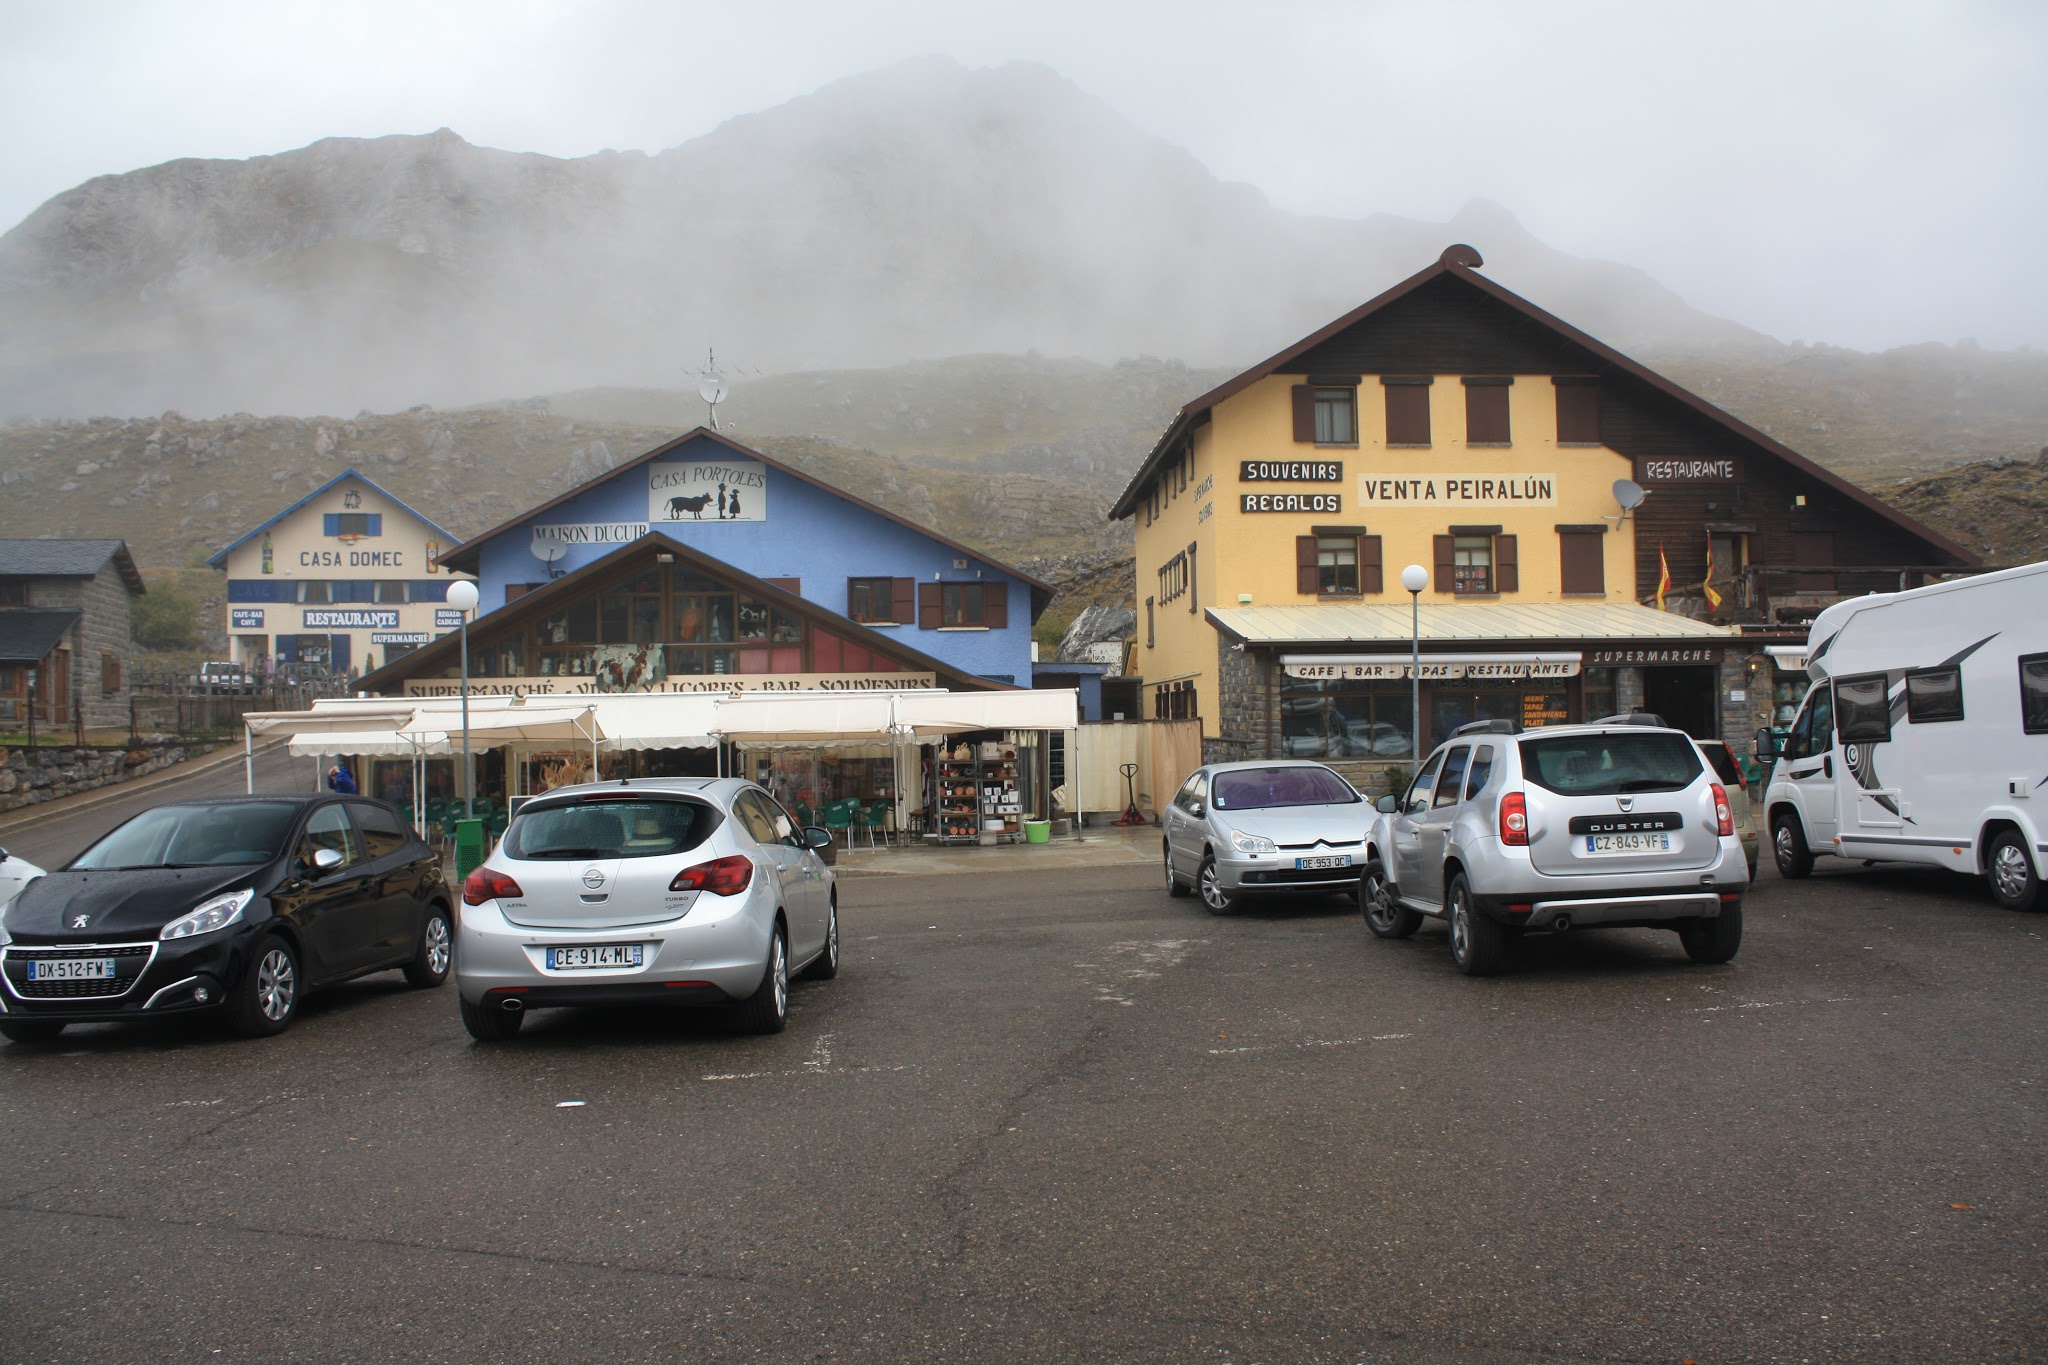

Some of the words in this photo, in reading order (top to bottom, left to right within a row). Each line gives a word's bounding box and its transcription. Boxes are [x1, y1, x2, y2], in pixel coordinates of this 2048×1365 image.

[1247, 463, 1337, 480] SOUVENIRS
[1646, 460, 1734, 479] RESTAURANTE
[650, 470, 686, 490] CASA
[694, 466, 765, 489] PORTOLES
[1365, 480, 1437, 500] VENTA
[1446, 475, 1552, 500] PEIRALÚN
[1246, 496, 1337, 511] REGALOS
[535, 526, 590, 542] MAISON
[300, 551, 342, 567] CASA
[350, 551, 403, 567] DOMEC
[306, 612, 397, 625] RESTAURANTE
[372, 632, 429, 643] SUPERMARCHÉ
[1594, 648, 1712, 662] SUPERMARCHÉ
[1299, 667, 1334, 676] CAFE
[1354, 666, 1383, 676] BAR
[1468, 664, 1569, 675] RESTAURANTE
[762, 680, 800, 690] BAR
[819, 678, 931, 690] SOUVENIRS
[1590, 822, 1664, 831] DUSTER
[1595, 834, 1658, 850] CZ-849-VF
[556, 947, 632, 965] CE-914-ML
[38, 961, 103, 977] DX-512-FW
